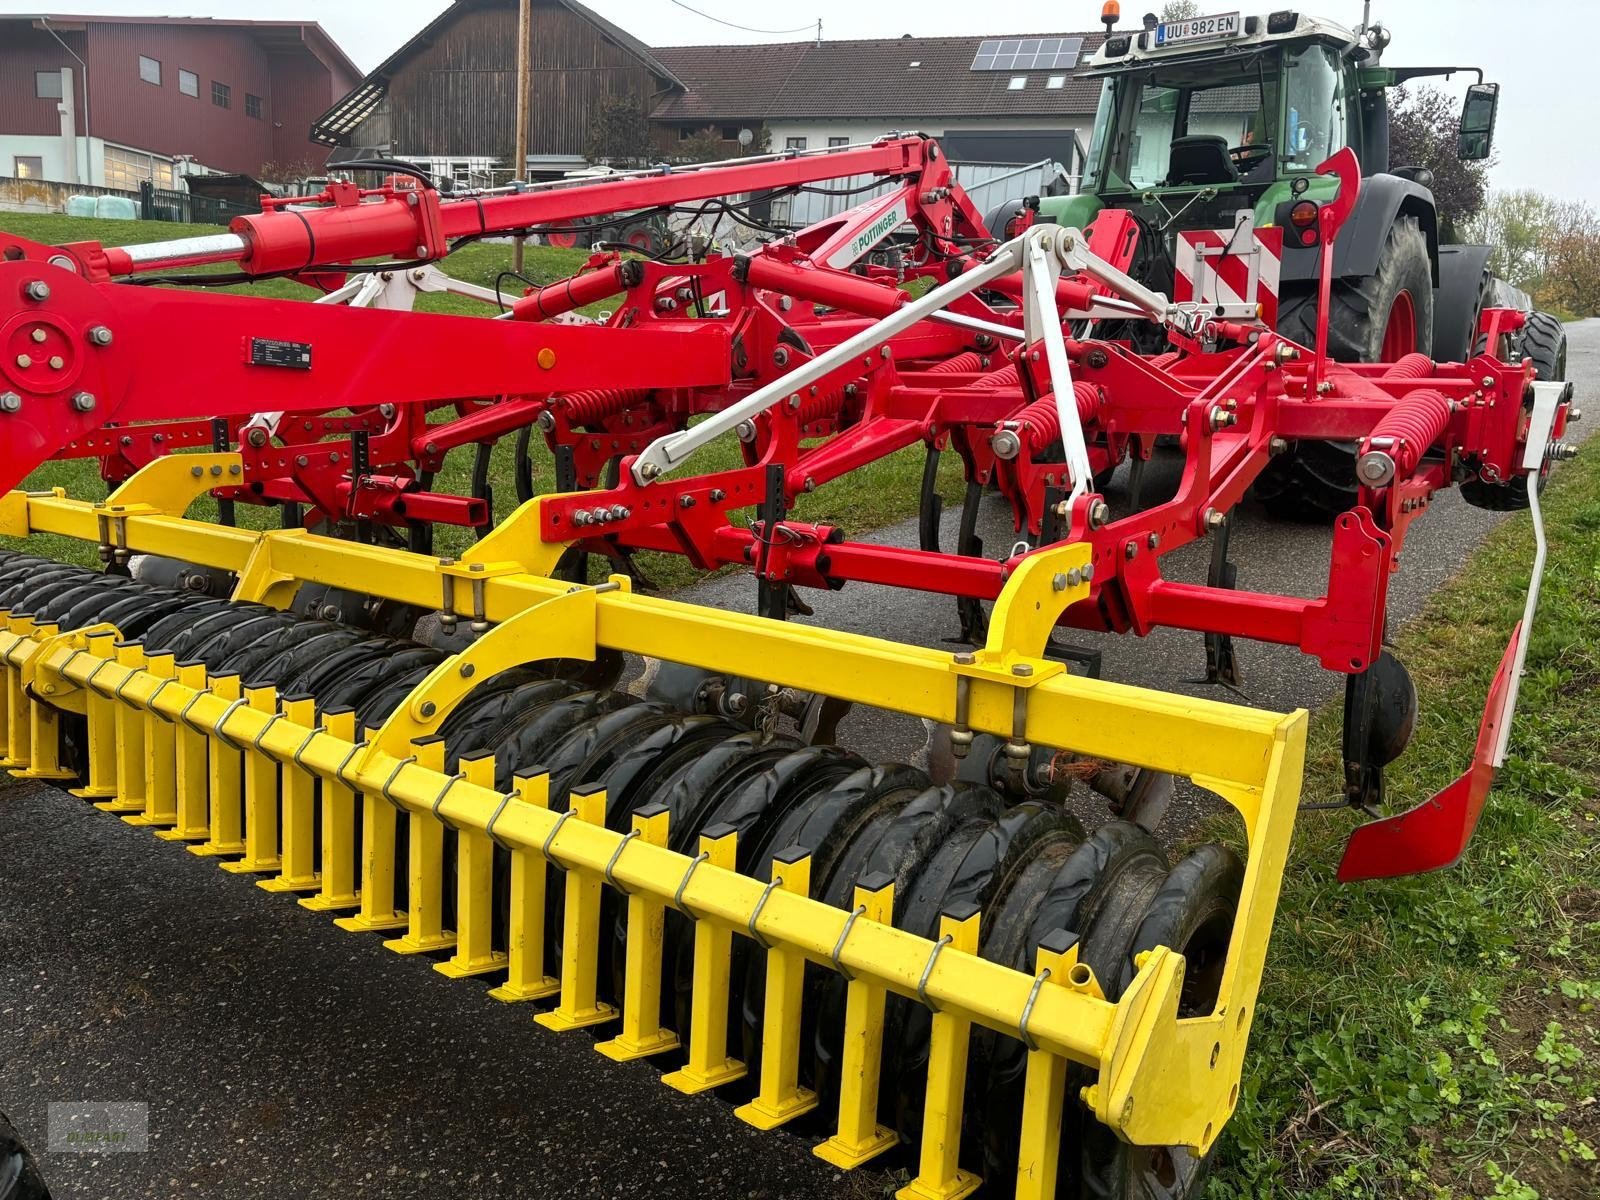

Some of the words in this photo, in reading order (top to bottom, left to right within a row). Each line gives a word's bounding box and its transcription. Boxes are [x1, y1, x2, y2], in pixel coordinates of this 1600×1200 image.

[1167, 25, 1182, 39] UU
[1191, 20, 1215, 35] 982
[1217, 16, 1234, 32] EN
